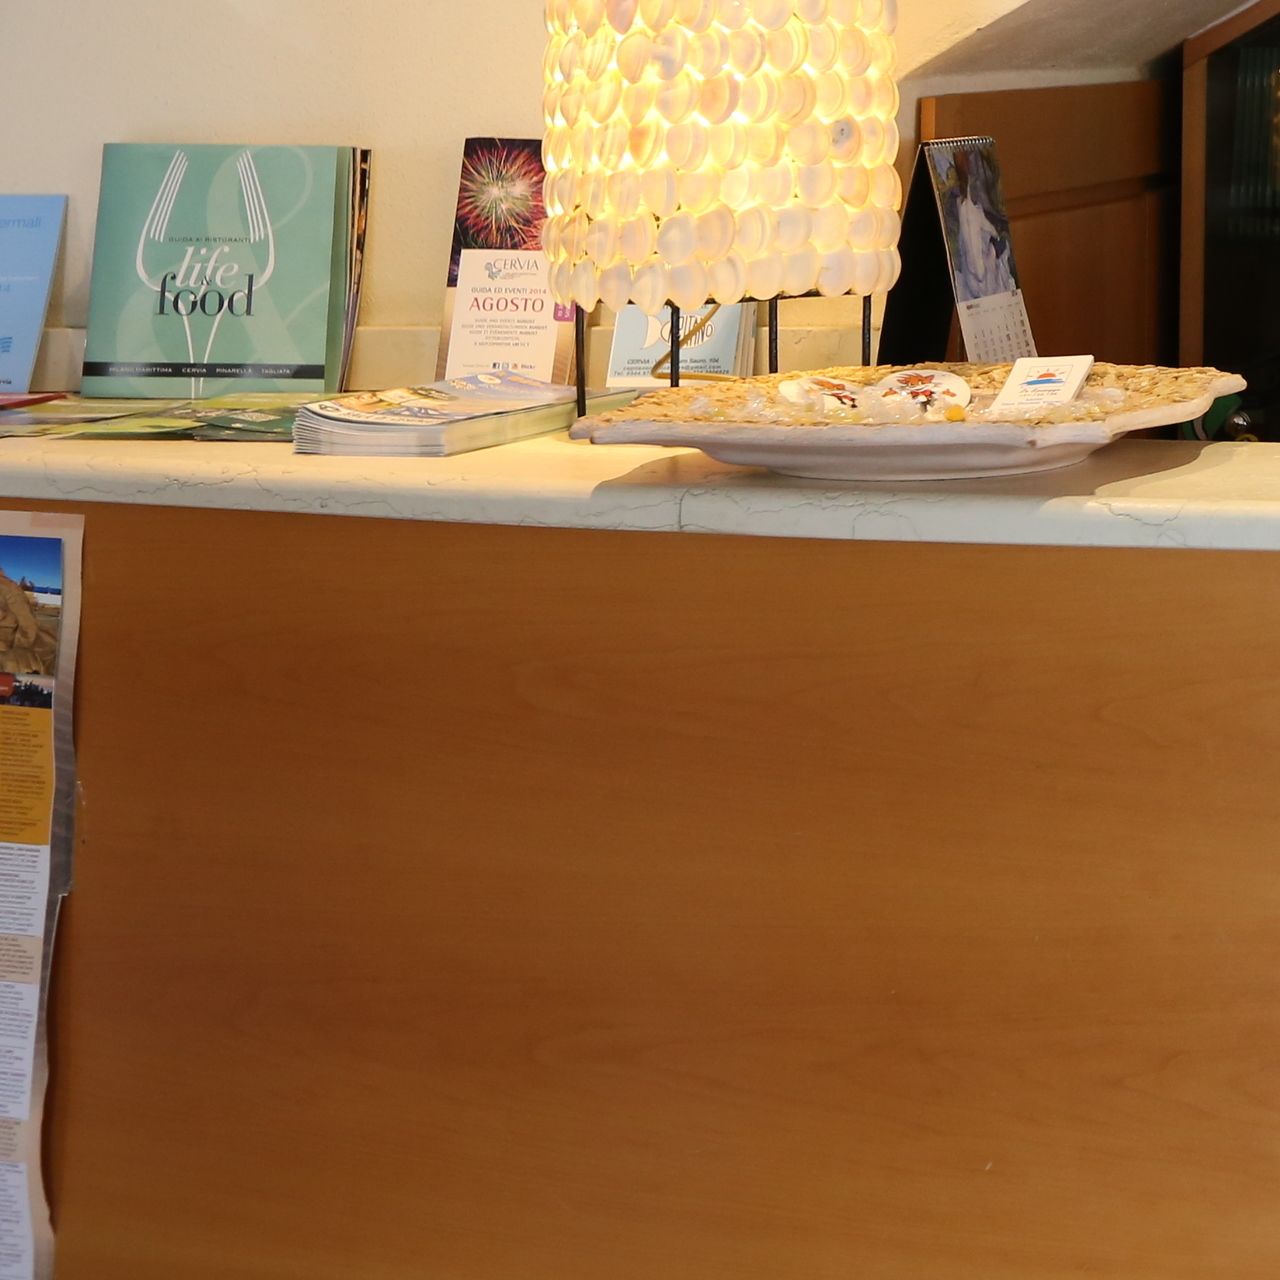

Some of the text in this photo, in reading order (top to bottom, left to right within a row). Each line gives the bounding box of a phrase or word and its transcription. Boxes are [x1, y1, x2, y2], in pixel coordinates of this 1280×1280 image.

[175, 245, 239, 289] life
[493, 257, 540, 271] CERVIA
[154, 271, 255, 317] food
[468, 296, 545, 313] AGOSTO
